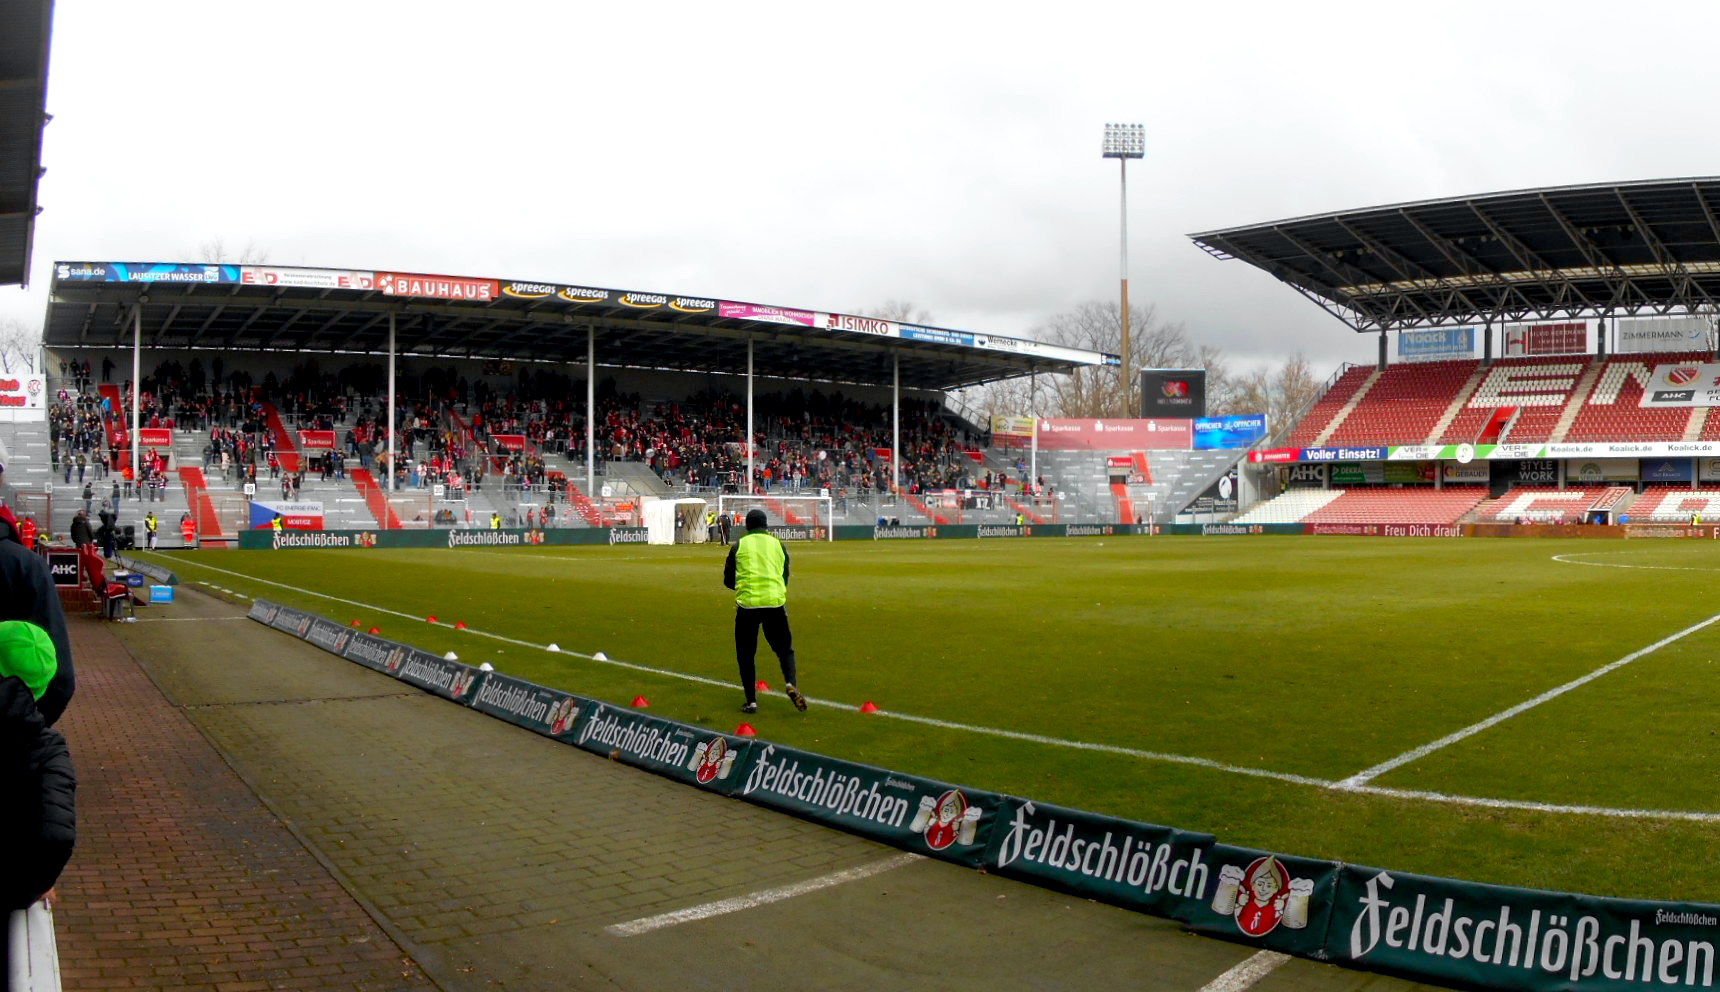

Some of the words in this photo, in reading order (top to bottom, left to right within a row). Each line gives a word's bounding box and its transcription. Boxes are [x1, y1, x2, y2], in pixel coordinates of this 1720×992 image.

[71, 267, 105, 276] sana.de
[128, 272, 170, 281] LAUSITZER
[171, 272, 203, 281] WASSER
[397, 281, 490, 298] BAUHAUS
[842, 316, 888, 334] ISIMKO
[988, 336, 1017, 347] Wernecke
[1405, 331, 1447, 344] Noack
[1052, 424, 1081, 432] Sparkasse
[1105, 424, 1134, 432] Sparkasse
[1158, 424, 1187, 432] Sparkasse
[142, 437, 168, 446] Sparkasse
[307, 438, 332, 447] Sparkasse
[1307, 449, 1336, 459] Voller
[1339, 448, 1380, 459] Einsatz!
[1520, 461, 1552, 470] STYLE
[1519, 471, 1553, 480] WORK
[245, 484, 253, 493] 19
[874, 524, 920, 541] Feldschlößchen
[978, 524, 1017, 538] Feldschlößchen
[1203, 524, 1246, 537] Feldschlößchen
[1385, 525, 1406, 537] Freu
[1409, 525, 1431, 537] Dich
[1434, 525, 1464, 537] drauf.
[272, 531, 350, 550] Feldschlößchen
[448, 529, 519, 548] Feldschlößchen
[51, 563, 76, 575] AHC
[399, 650, 452, 689] Feldschlößchen
[473, 671, 547, 723] Feldschlößchen
[580, 704, 689, 767] Feldschlößchen
[745, 741, 908, 826] Feldschlößchen
[1656, 908, 1717, 926] Feldschlößchen
[1351, 870, 1715, 988] Feldschlößchen
